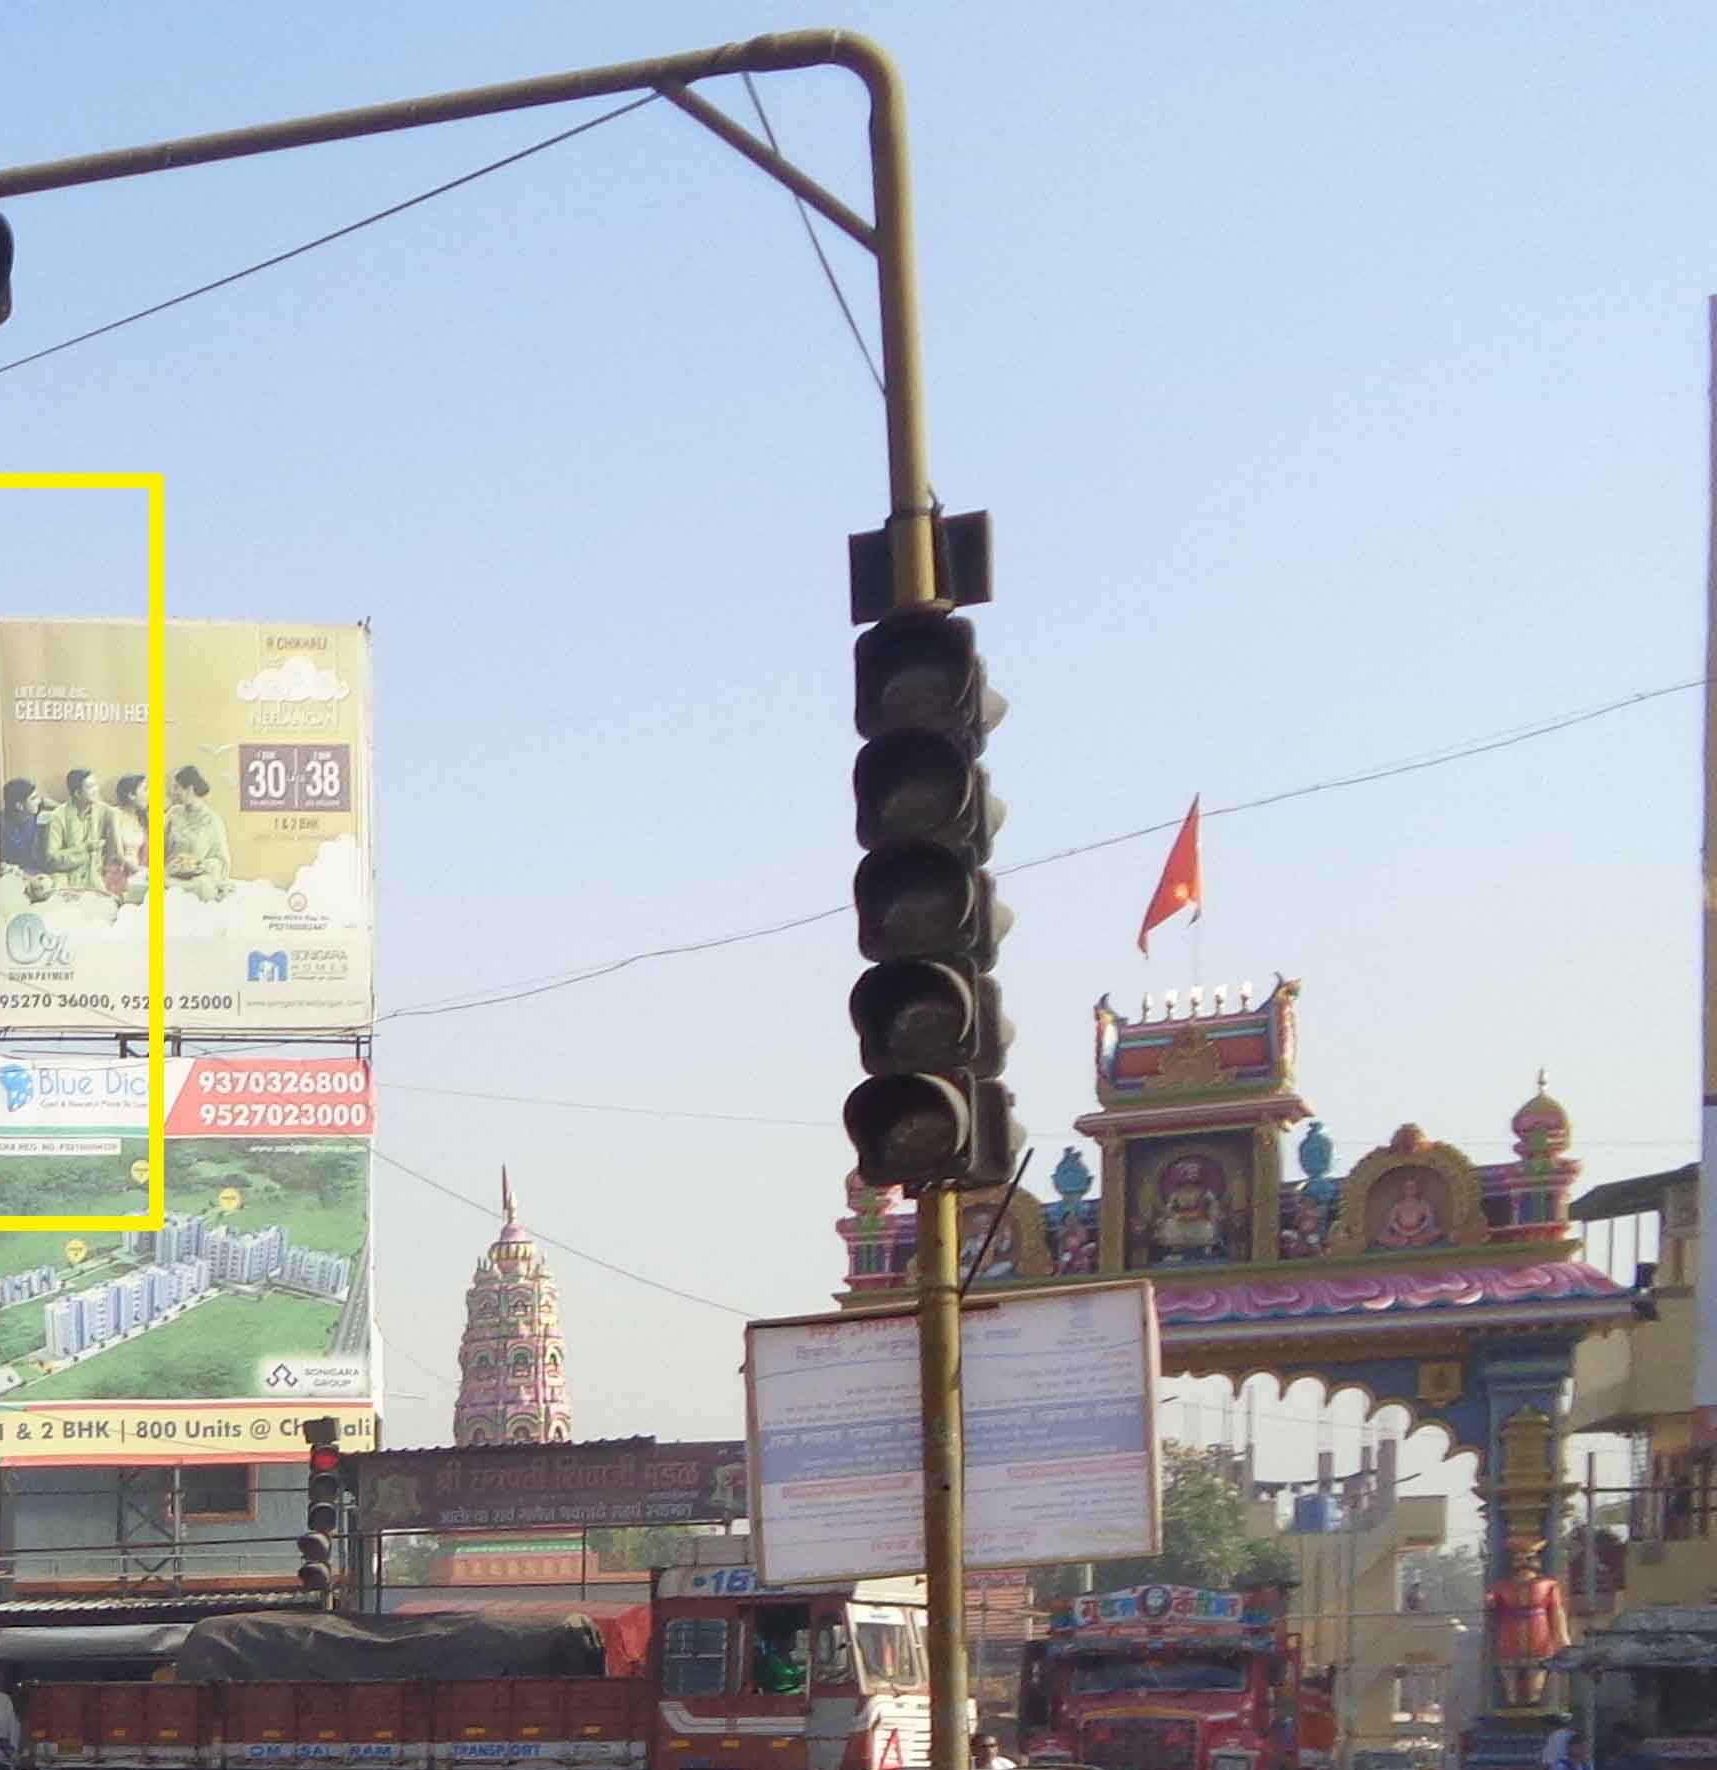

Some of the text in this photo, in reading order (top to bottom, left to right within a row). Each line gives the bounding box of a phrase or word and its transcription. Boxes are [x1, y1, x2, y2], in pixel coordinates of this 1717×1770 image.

[16, 701, 120, 721] CELEBRATION
[248, 760, 341, 798] 30 38
[0, 994, 52, 1008] 95270
[57, 994, 115, 1012] 36000,
[121, 995, 172, 1009] 9520
[179, 995, 233, 1009] 25000
[38, 1069, 150, 1095] Blue Dic
[197, 1071, 367, 1094] 9370326800
[199, 1103, 367, 1127] 9527023000
[16, 1424, 33, 1440] &
[41, 1422, 54, 1440] 2
[63, 1421, 110, 1439] BHK
[135, 1420, 177, 1439] 800
[186, 1419, 242, 1438] Units
[249, 1418, 271, 1440] @
[251, 1746, 282, 1758] OM
[349, 1746, 394, 1758] RAM
